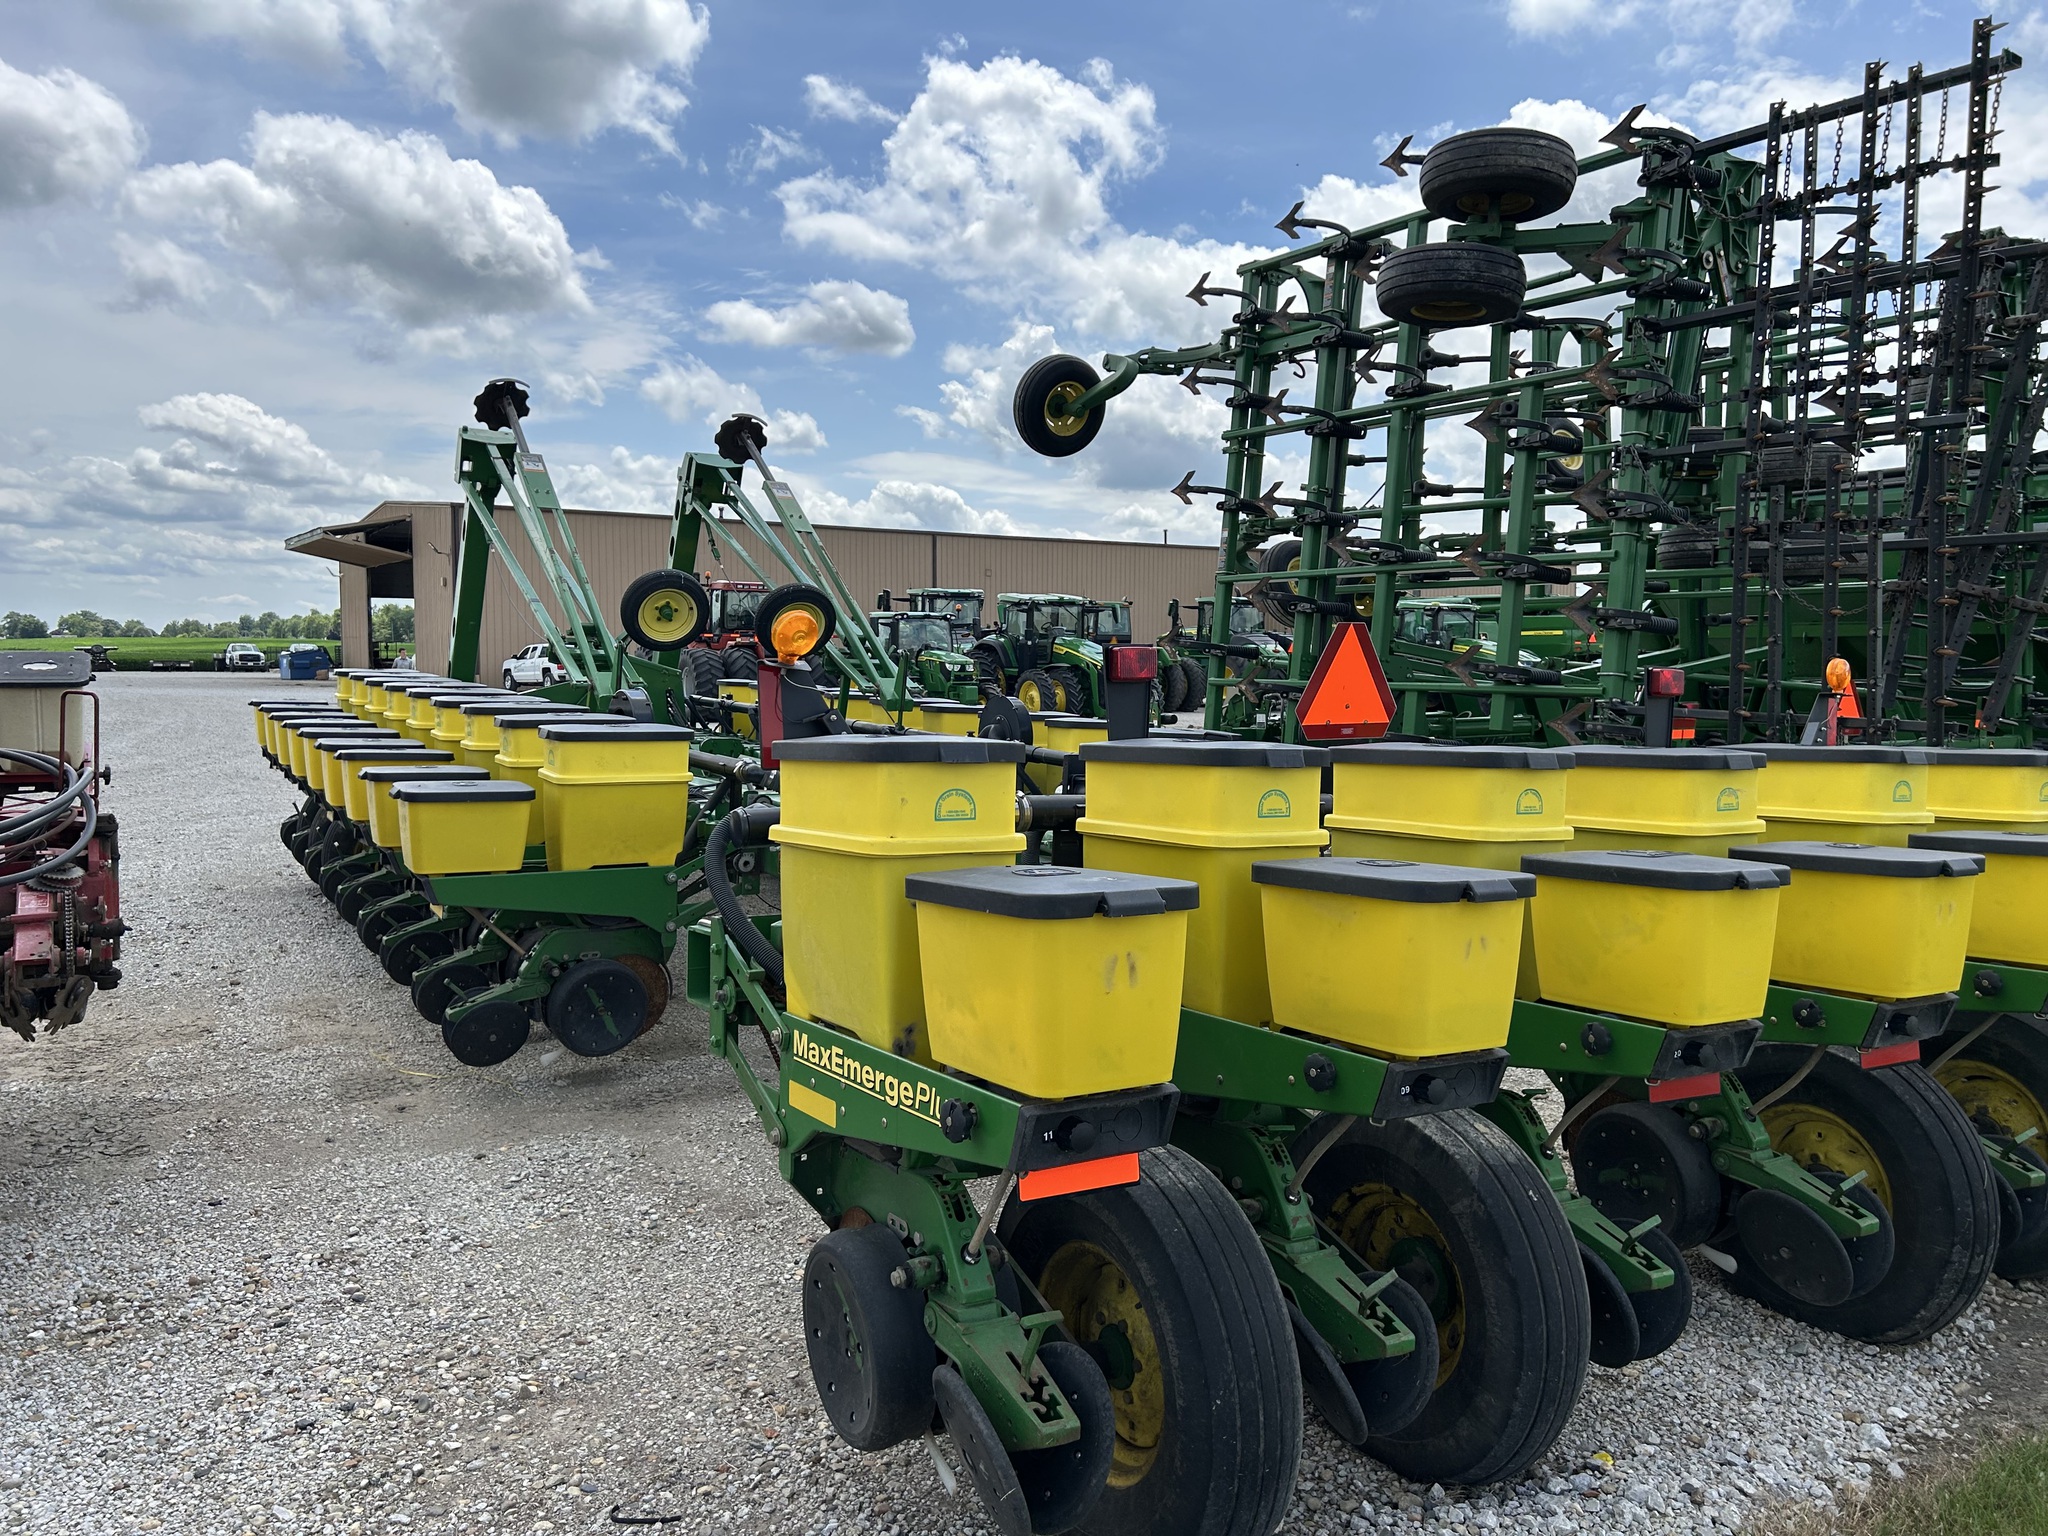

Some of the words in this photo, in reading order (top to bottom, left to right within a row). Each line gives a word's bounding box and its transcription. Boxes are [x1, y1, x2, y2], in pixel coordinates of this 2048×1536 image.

[793, 1029, 948, 1120] MaxEmergePlu
[1400, 1085, 1410, 1095] 09
[1043, 1130, 1053, 1141] 11
